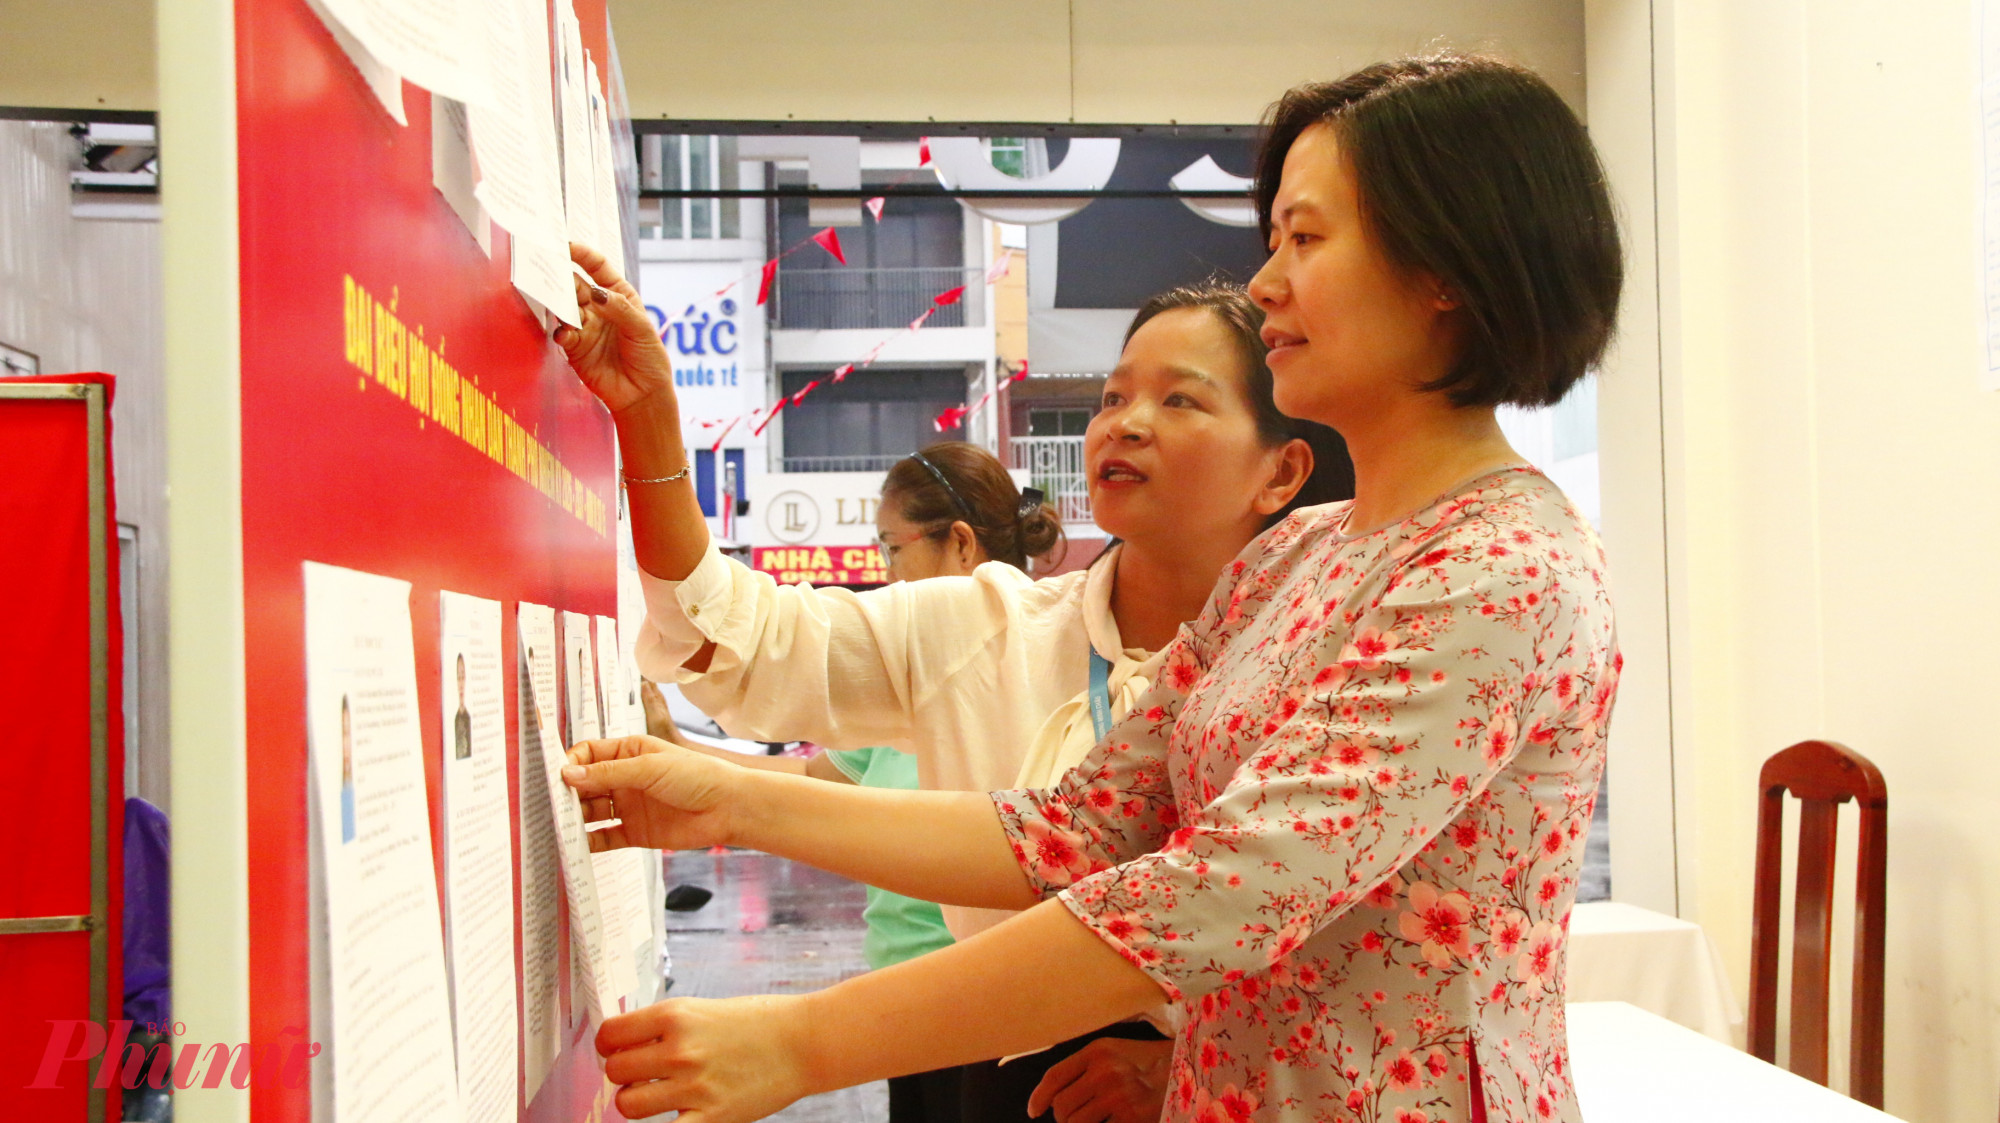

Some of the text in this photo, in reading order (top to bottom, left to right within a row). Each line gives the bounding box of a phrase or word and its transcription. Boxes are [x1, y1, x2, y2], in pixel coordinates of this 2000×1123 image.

[344, 273, 373, 391] ĐẠI
[375, 284, 407, 400] BIỂU
[409, 323, 430, 429] HỘI
[431, 335, 460, 437] ĐỒNG
[461, 374, 487, 454] NHÂN
[487, 391, 504, 466] DÂN
[842, 548, 887, 570] CH
